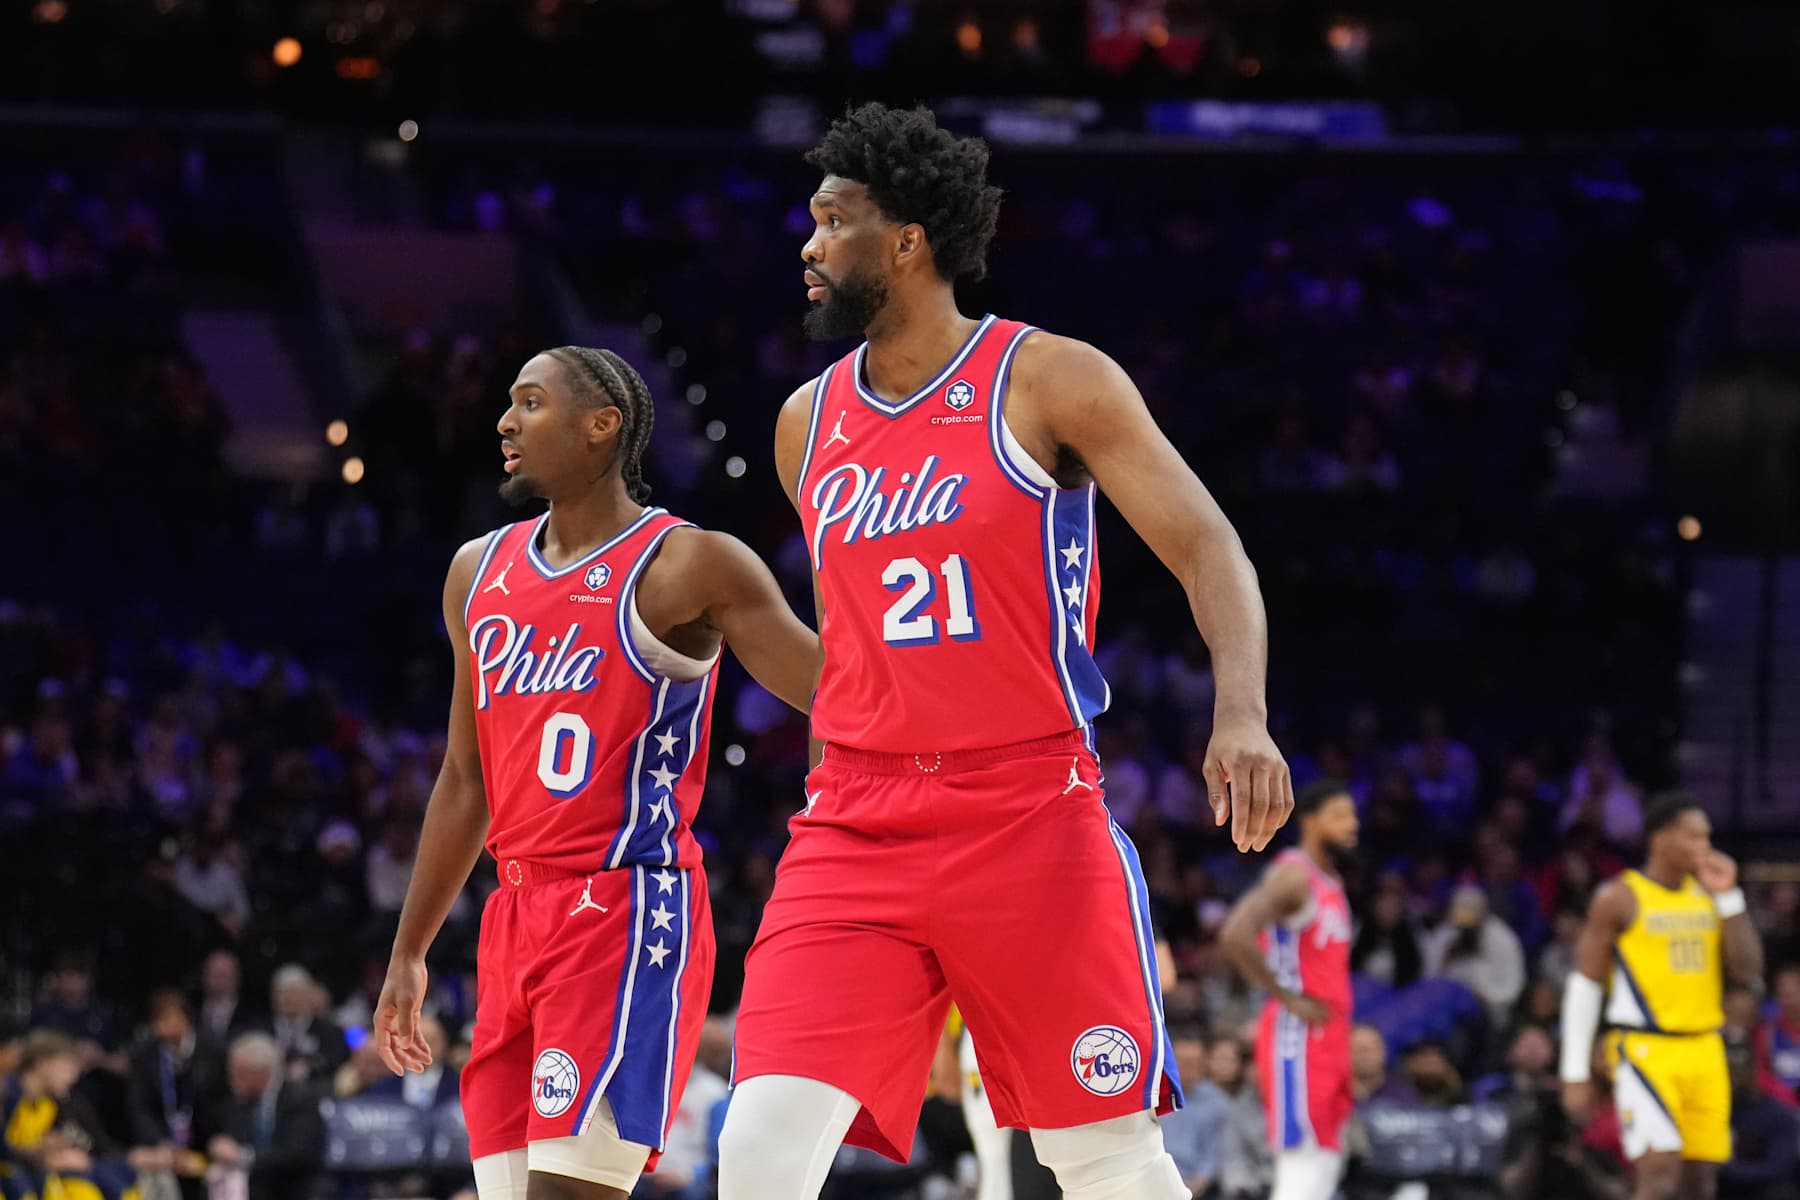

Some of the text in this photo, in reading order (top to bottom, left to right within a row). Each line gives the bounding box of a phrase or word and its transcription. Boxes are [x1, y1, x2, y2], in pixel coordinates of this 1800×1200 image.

[931, 415, 983, 426] crypto.com
[811, 455, 969, 571] Phila
[569, 594, 613, 605] crypto.com
[881, 553, 982, 647] 21
[469, 614, 605, 711] Phila
[537, 711, 596, 798] 0
[535, 1075, 572, 1099] 76ers
[1079, 1053, 1135, 1080] 76ers
